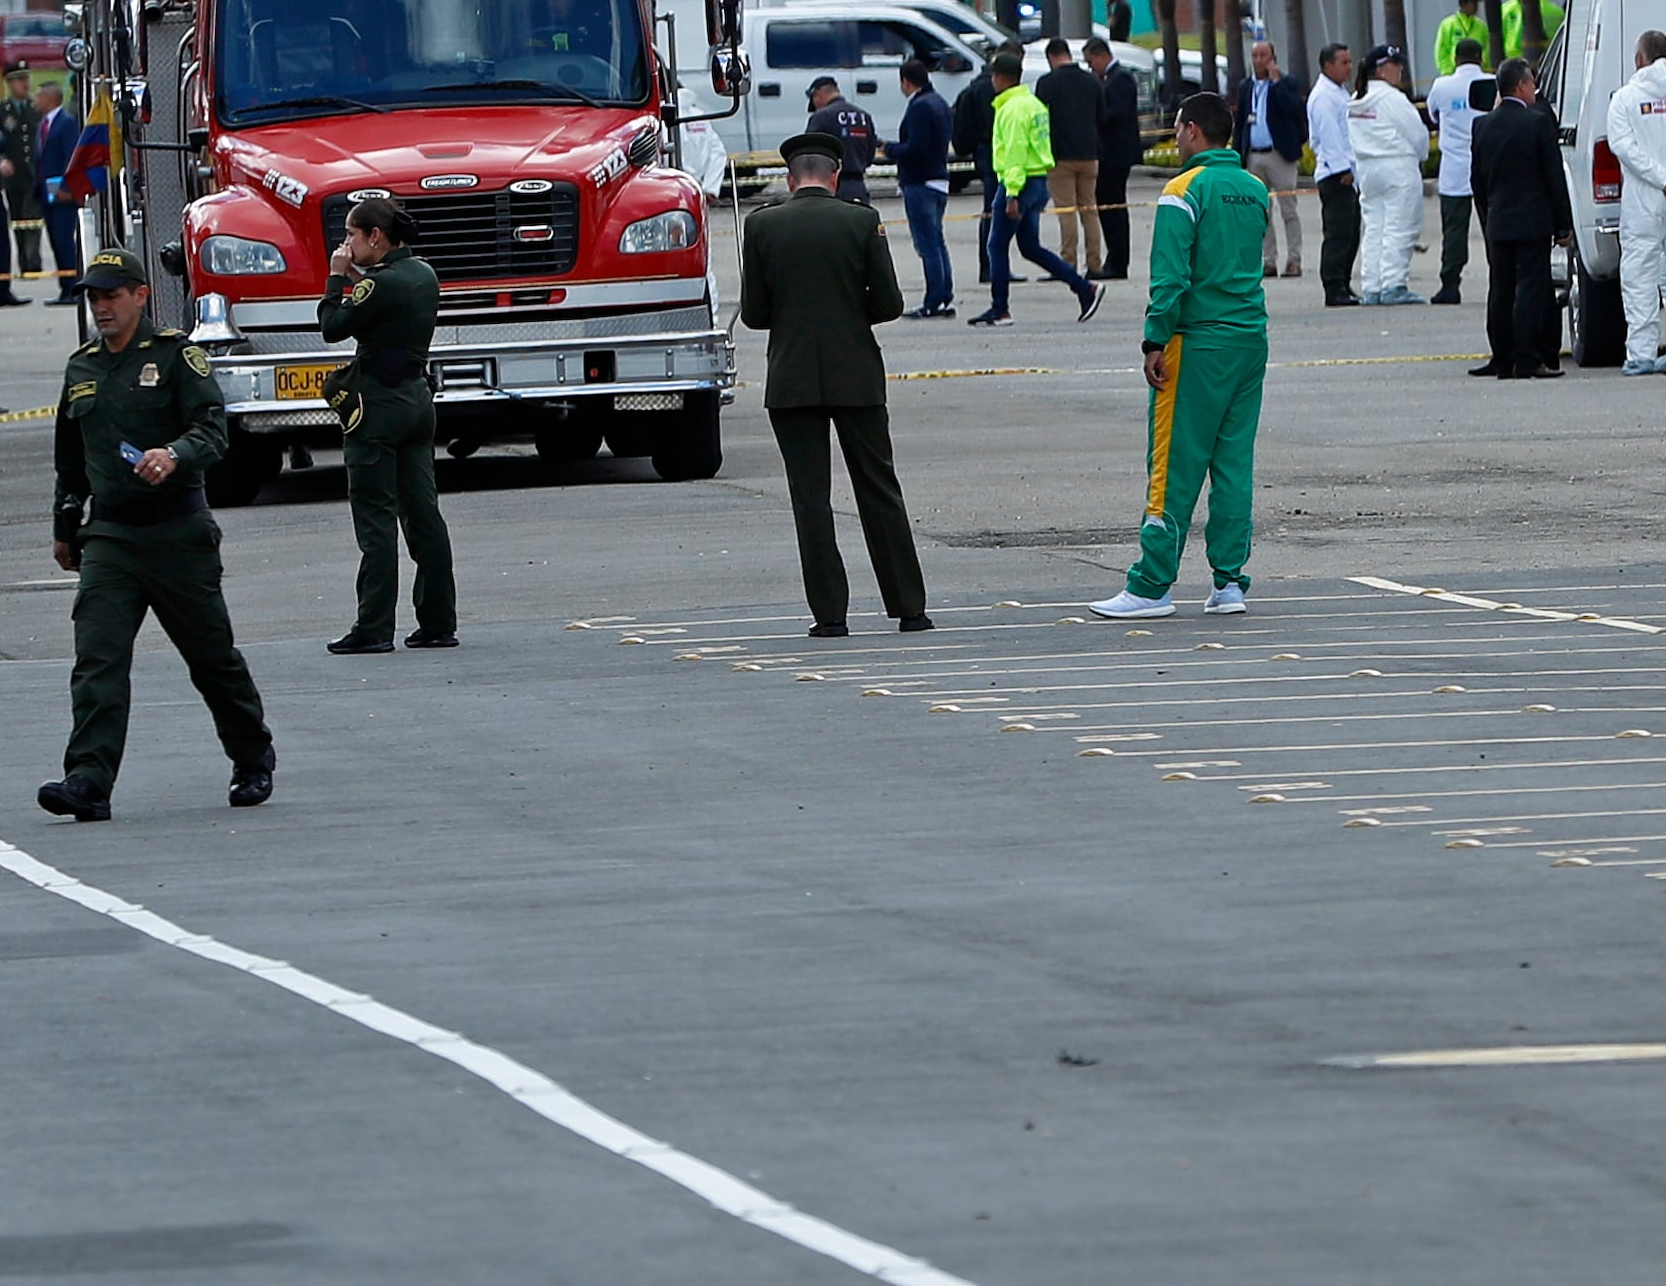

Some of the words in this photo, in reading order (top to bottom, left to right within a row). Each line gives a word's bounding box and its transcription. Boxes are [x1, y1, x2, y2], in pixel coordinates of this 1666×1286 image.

[837, 111, 866, 125] CTI
[603, 148, 628, 178] 123
[276, 175, 308, 204] 123
